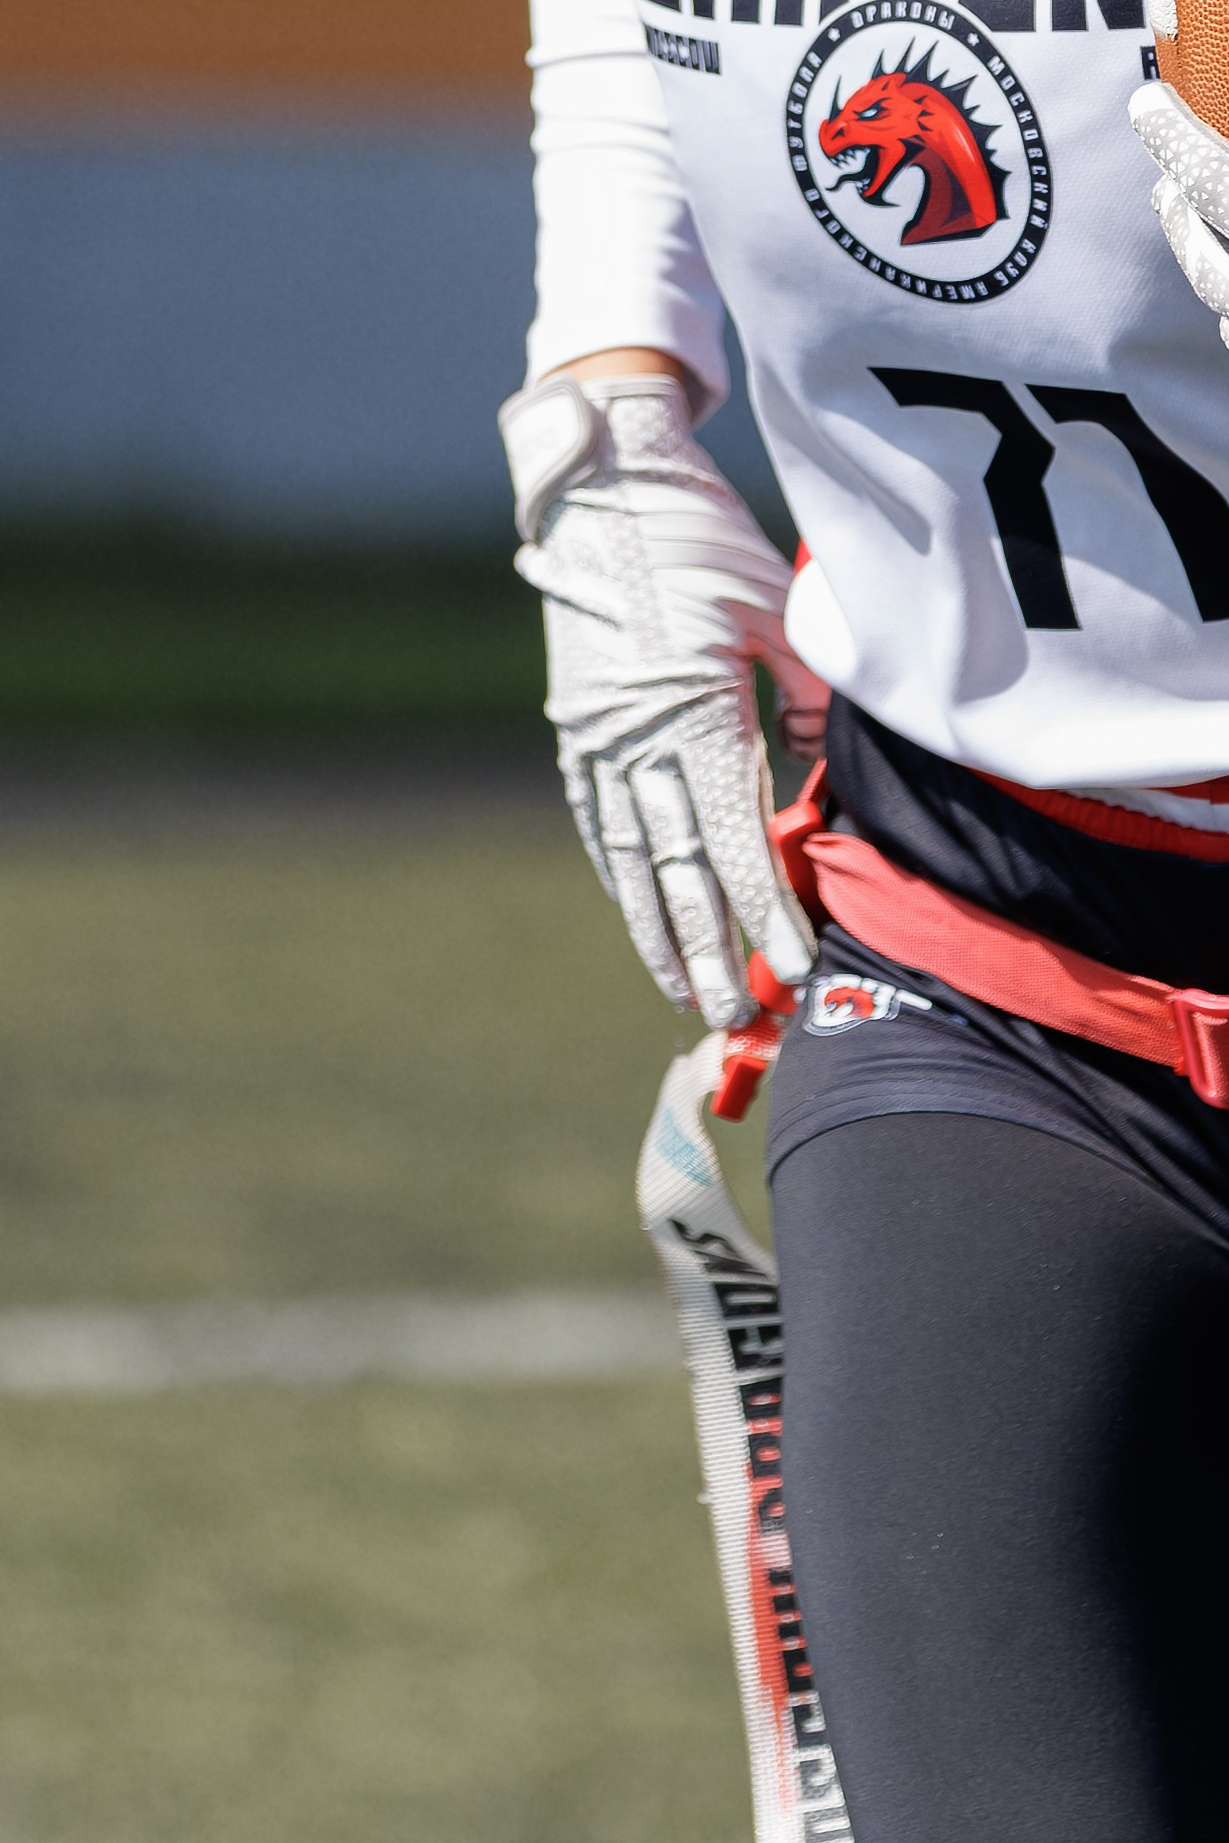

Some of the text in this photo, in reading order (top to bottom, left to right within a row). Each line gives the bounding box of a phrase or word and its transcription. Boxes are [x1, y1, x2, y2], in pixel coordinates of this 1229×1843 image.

[850, 1, 955, 30] ДРАКОНЫ
[788, 50, 823, 173] ФУТБОЛА
[986, 55, 1049, 229] МОСКОВСКИЙ
[993, 237, 1037, 287] КЛУБ
